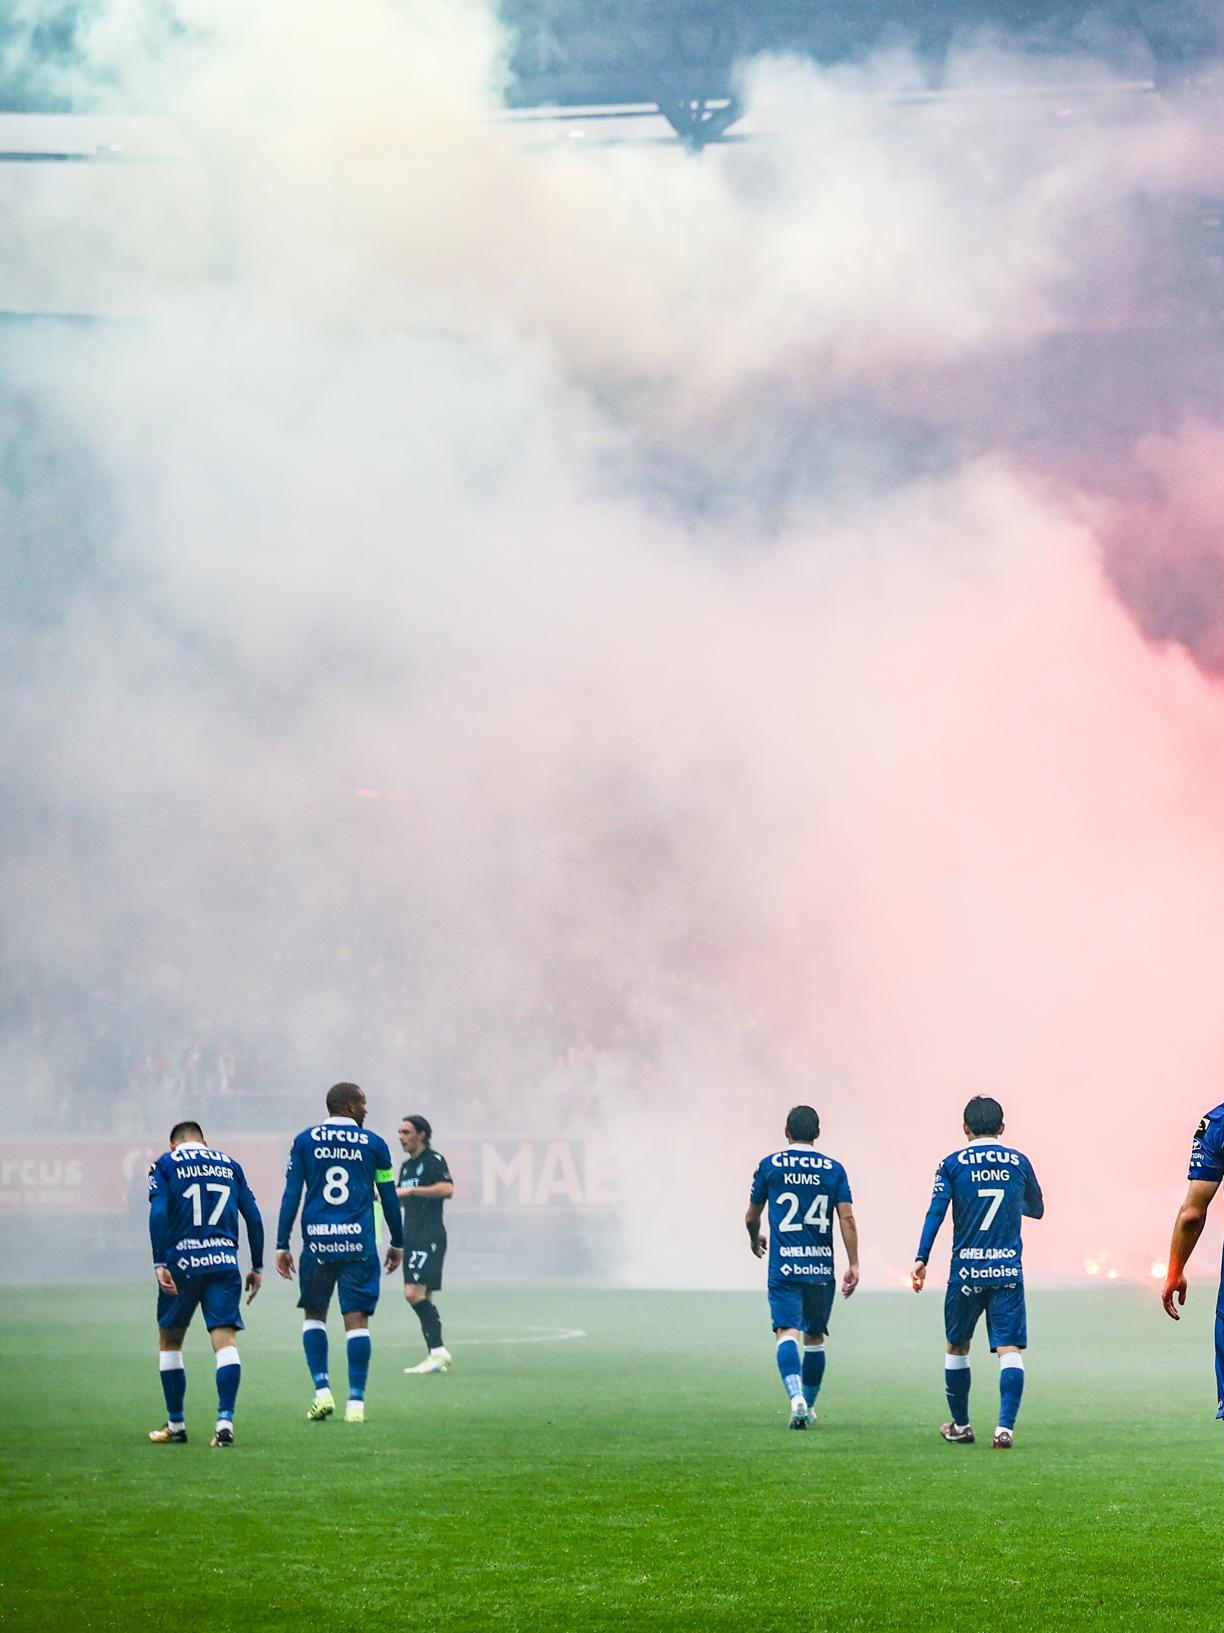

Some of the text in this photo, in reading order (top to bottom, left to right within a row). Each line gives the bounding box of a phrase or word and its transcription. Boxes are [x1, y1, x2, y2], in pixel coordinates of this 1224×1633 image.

[311, 1126, 369, 1144] Circus
[314, 1147, 363, 1161] ODJIDJA
[771, 1152, 833, 1170] Circus
[957, 1149, 1020, 1166] Circus
[177, 1164, 234, 1180] HJULSAGER
[784, 1173, 820, 1186] KUMS
[971, 1169, 1010, 1182] HONG
[323, 1166, 349, 1205] 8
[182, 1183, 231, 1226] 17
[978, 1189, 1005, 1231] 7
[776, 1191, 830, 1234] 24
[307, 1223, 362, 1236] GHELAMCO
[318, 1240, 364, 1253] baloise
[780, 1246, 832, 1257] GHELAMCO
[959, 1248, 1017, 1260] GHELAMCO
[191, 1252, 237, 1268] baloise
[794, 1263, 832, 1275] baloise
[970, 1264, 1018, 1279] baloise
